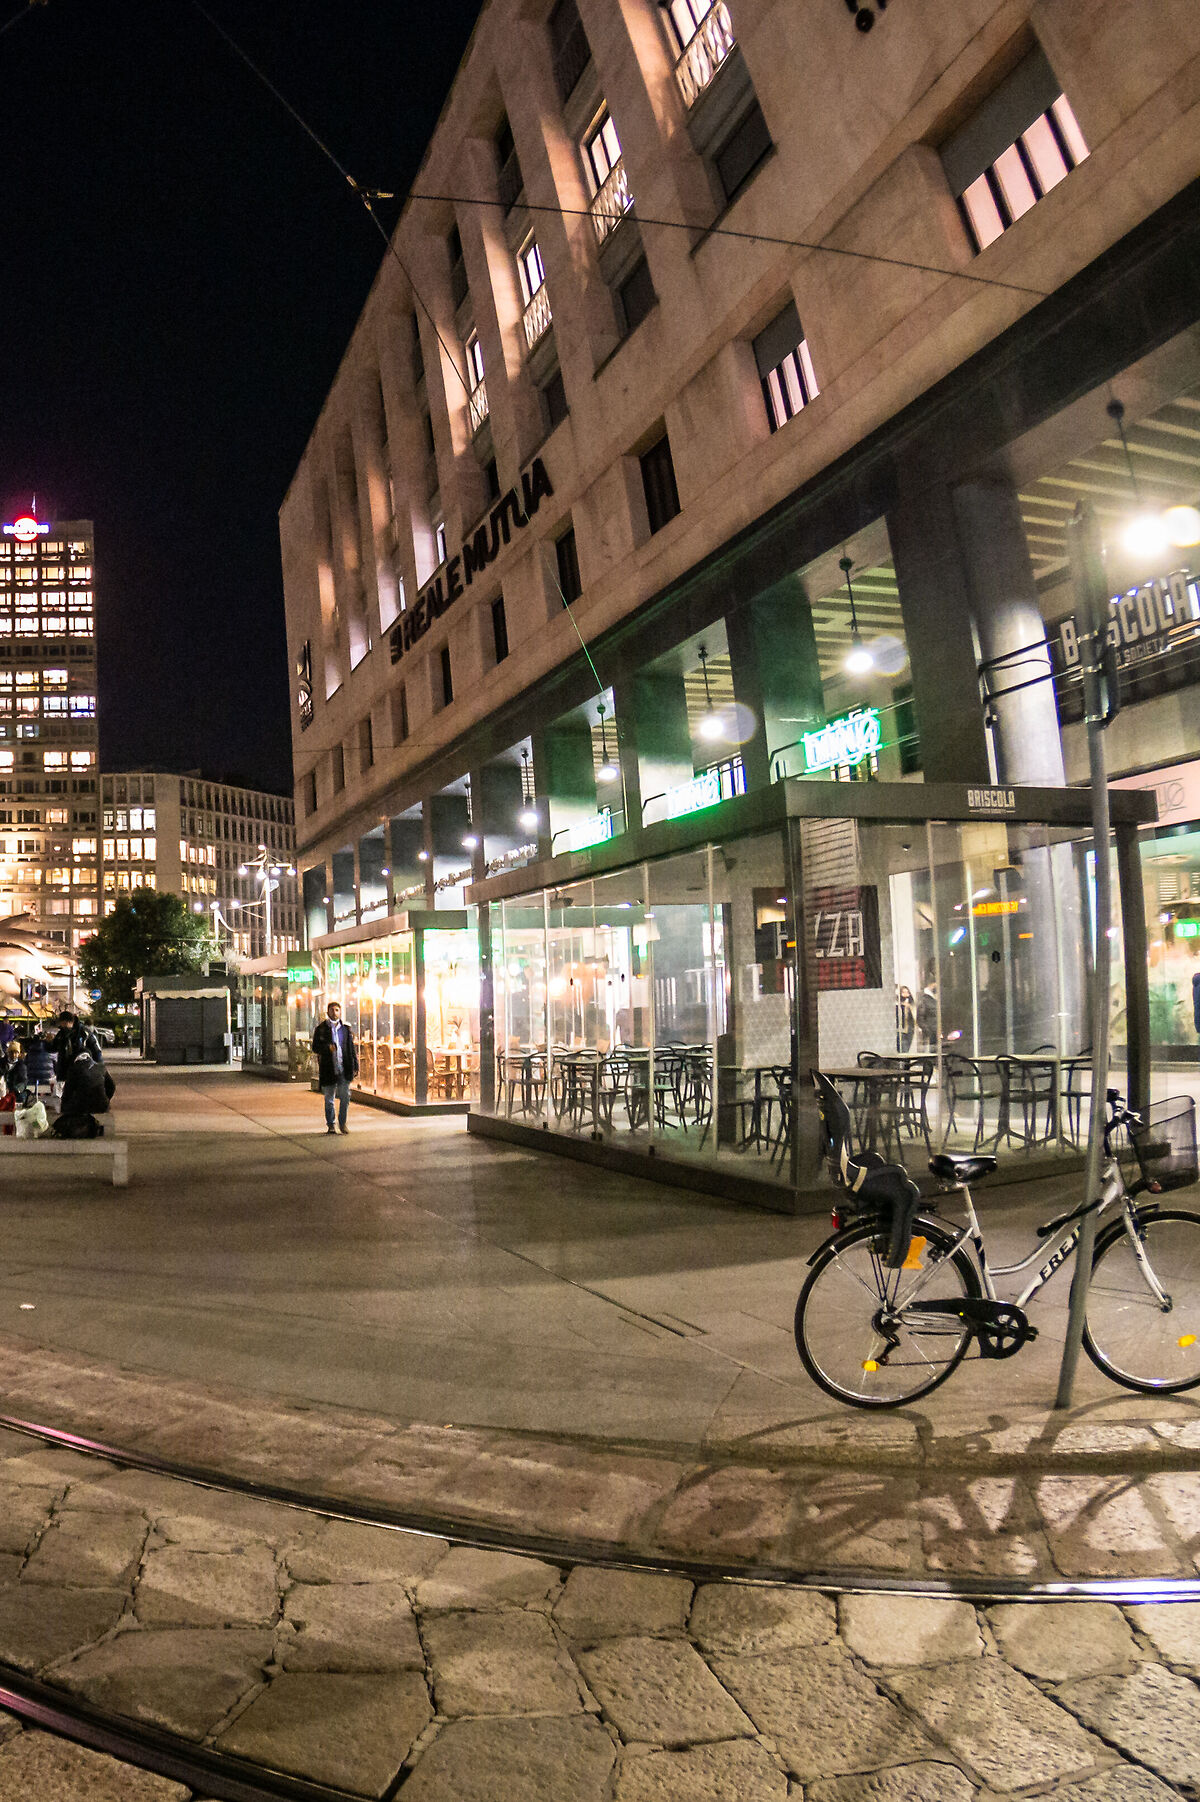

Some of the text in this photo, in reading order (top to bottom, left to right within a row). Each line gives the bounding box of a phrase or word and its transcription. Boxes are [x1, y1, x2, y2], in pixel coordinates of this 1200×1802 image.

[403, 457, 555, 652] REALE MUTUA
[1060, 572, 1192, 666] BSCOLA
[967, 789, 1016, 808] BRISCOLA
[1039, 1224, 1081, 1283] FREJ
